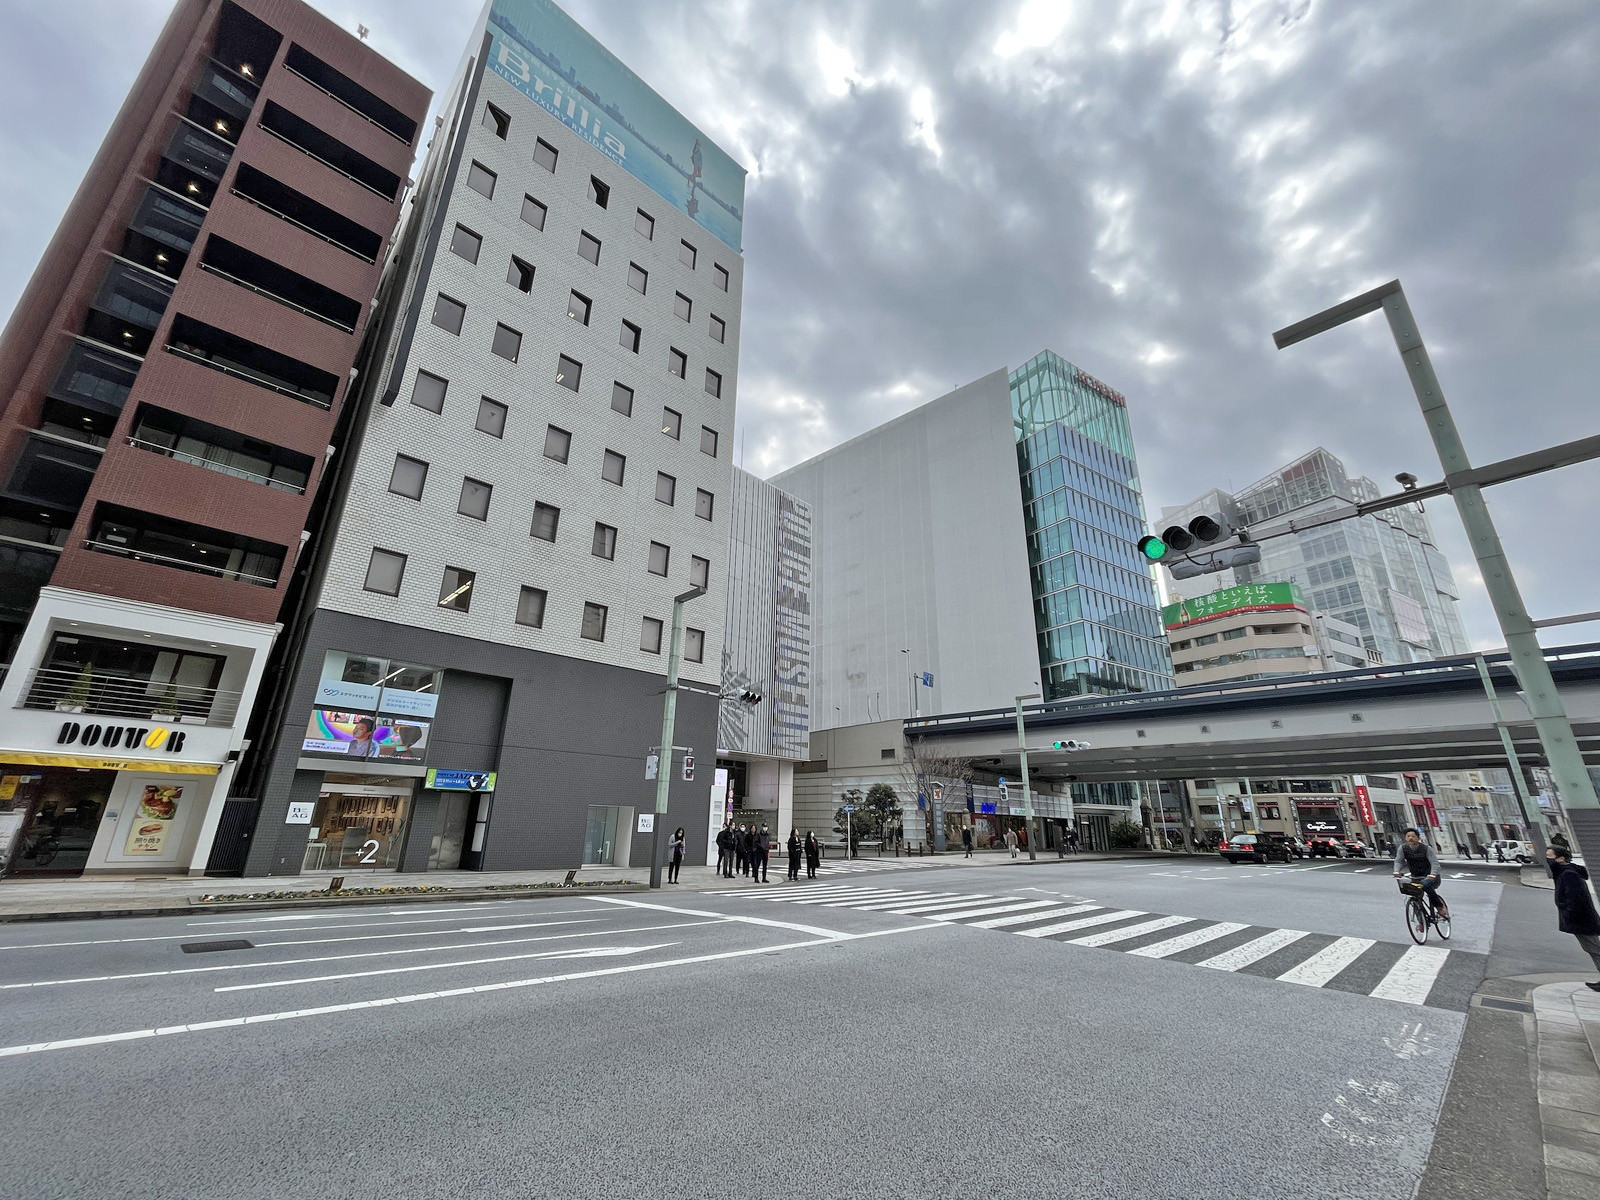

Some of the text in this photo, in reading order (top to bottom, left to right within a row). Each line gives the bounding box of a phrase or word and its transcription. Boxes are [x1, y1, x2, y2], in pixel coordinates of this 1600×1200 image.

[494, 64, 625, 166] NEW LUXURY RESIDENCE
[497, 40, 627, 160] Brillia
[773, 493, 811, 757] POLICE MUSEUM
[1194, 584, 1273, 608] 核酸といえば、
[57, 721, 187, 753] DOUTOR
[355, 839, 380, 864] +2
